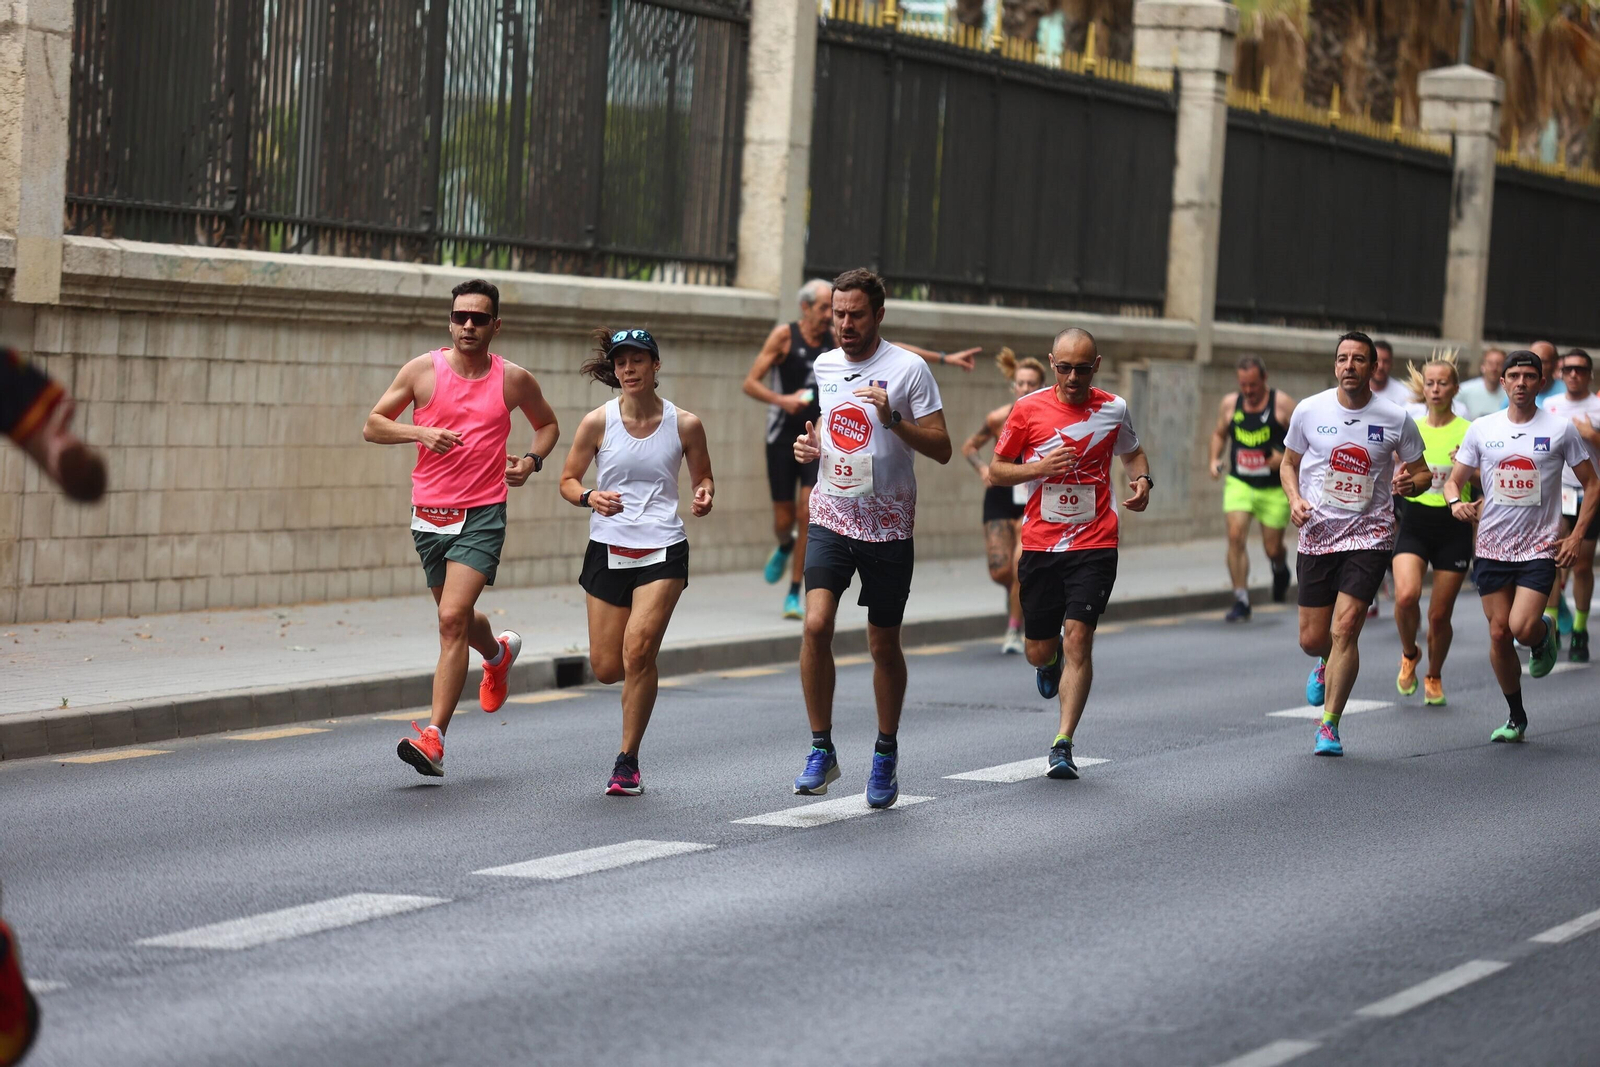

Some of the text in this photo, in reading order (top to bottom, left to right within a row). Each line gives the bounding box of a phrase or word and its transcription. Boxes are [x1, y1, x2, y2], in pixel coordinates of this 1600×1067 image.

[834, 414, 867, 434] PONLE
[832, 423, 864, 442] FRENO
[1368, 432, 1382, 441] AXA
[1534, 443, 1548, 451] AXA
[1336, 452, 1367, 468] PONLE
[834, 464, 853, 476] 53
[1334, 480, 1362, 494] 223
[1500, 479, 1534, 489] 1186
[1059, 494, 1078, 506] 90
